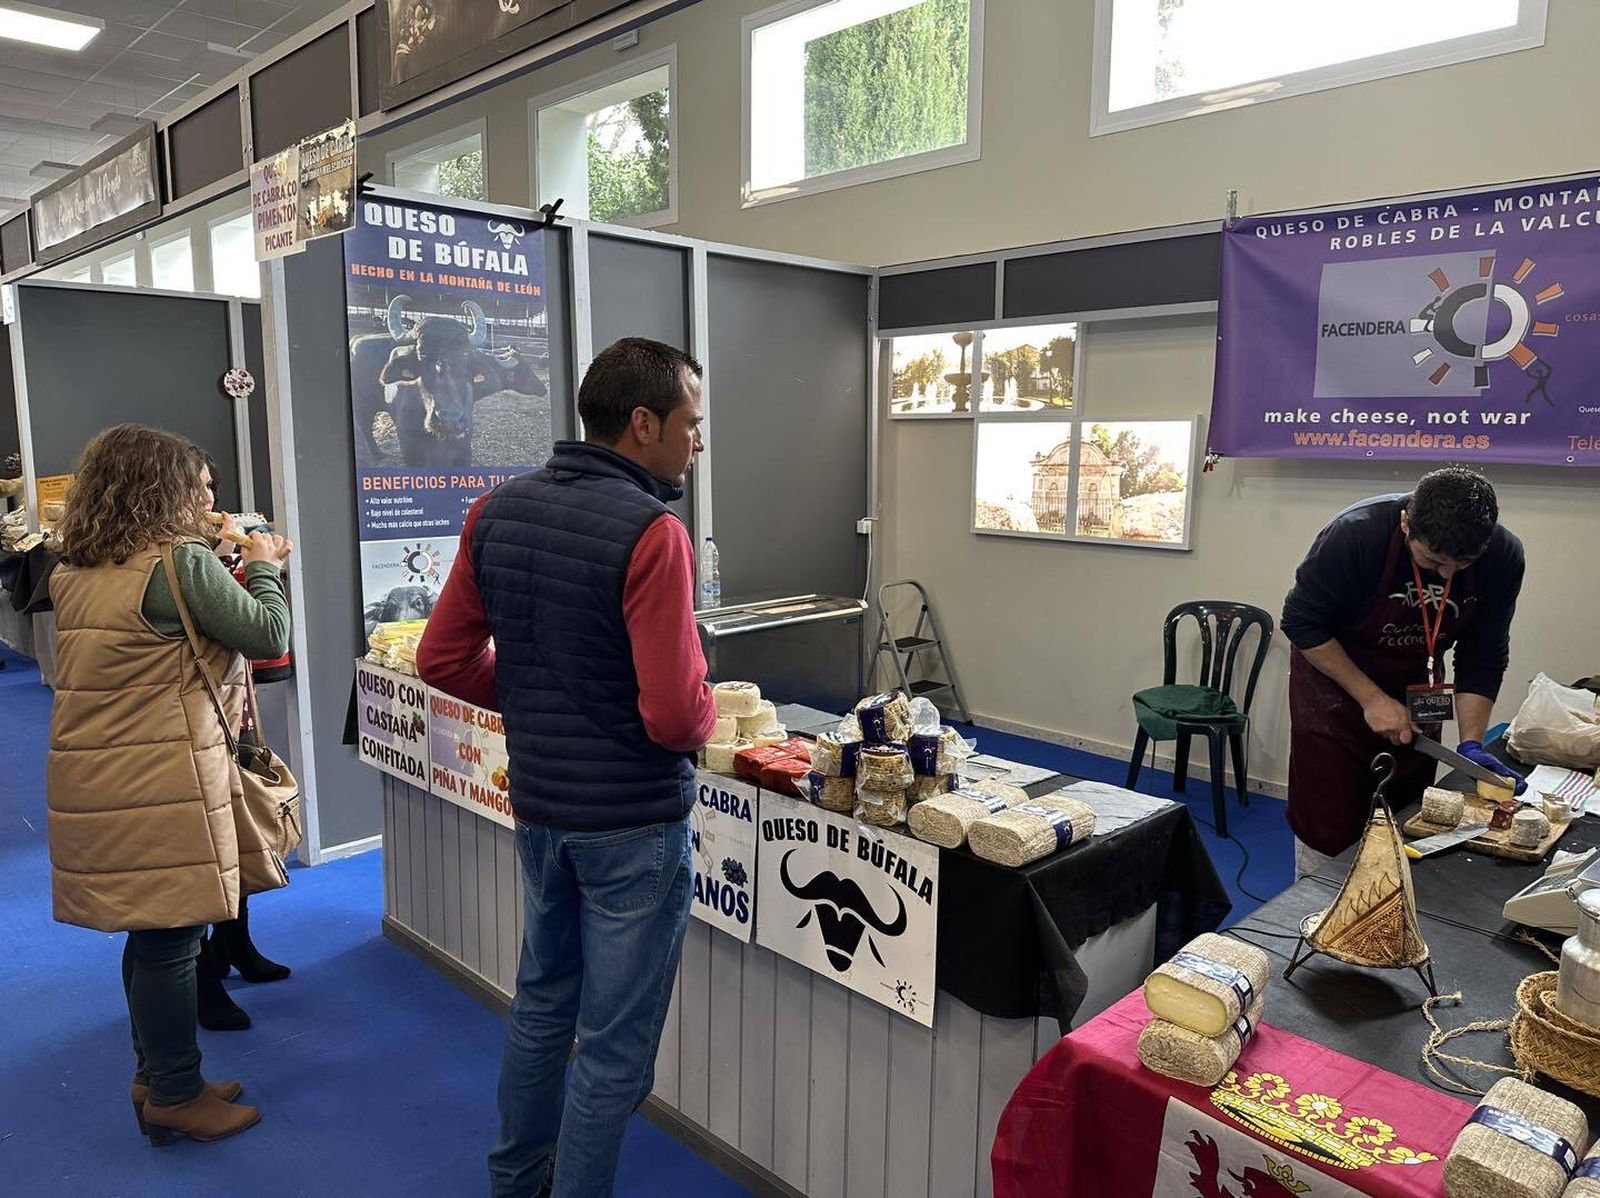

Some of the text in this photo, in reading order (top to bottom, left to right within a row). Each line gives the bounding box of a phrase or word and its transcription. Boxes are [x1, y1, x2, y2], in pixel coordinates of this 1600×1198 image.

[262, 184, 285, 206] CABRA
[287, 180, 297, 197] CO
[364, 202, 456, 236] QUESO
[1256, 219, 1325, 239] QUESO
[1338, 215, 1364, 230] DE
[1377, 205, 1458, 226] CABRA
[1330, 230, 1417, 251] ROBLES
[1430, 226, 1460, 241] DE
[1475, 220, 1504, 237] LA
[265, 231, 293, 251] PICANTE
[388, 236, 529, 276] DE BÚFALA
[351, 263, 541, 296] HECHO EN LA MONTAÑA DE LEÓN
[1321, 320, 1406, 338] FACENDERA
[1264, 407, 1531, 426] make cheese, not war
[1294, 430, 1490, 449] www.facendera.es
[362, 476, 446, 491] BENEFICIOS
[450, 475, 485, 489] PARA
[370, 509, 381, 517] Bajo
[413, 520, 422, 529] que
[435, 518, 449, 526] leches
[358, 668, 425, 711] QUESO CON
[366, 704, 418, 743] CASTAÑA
[430, 695, 506, 736] QUESO DE CABR
[362, 735, 426, 782] CONFITADA
[458, 741, 482, 766] CON
[432, 766, 512, 817] PIÑA Y MANGO
[699, 784, 753, 823] CABRA
[762, 818, 933, 906] QUESO DE BÚFALA
[693, 870, 750, 925] ANOS
